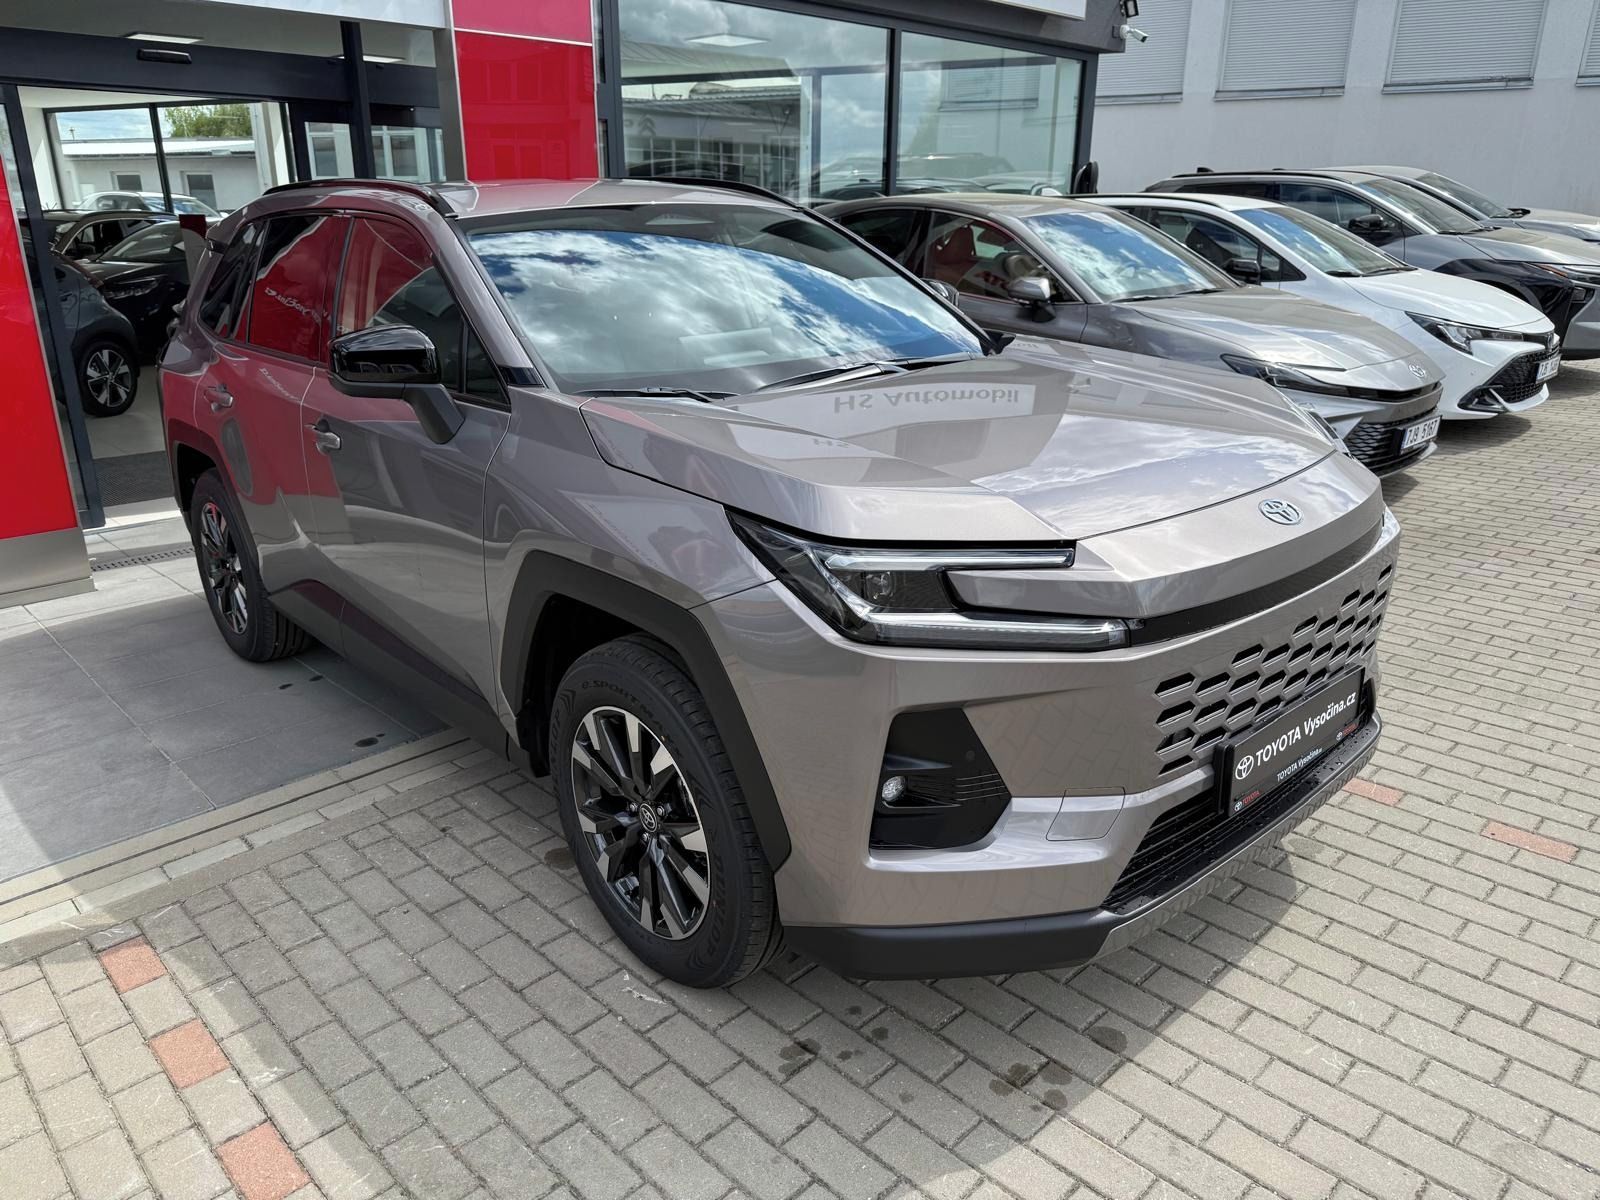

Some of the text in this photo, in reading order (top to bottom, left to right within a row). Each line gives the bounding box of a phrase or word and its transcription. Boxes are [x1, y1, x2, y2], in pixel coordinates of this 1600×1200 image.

[1256, 691, 1357, 766] TOYOTA Vysočina.cz
[1276, 763, 1298, 782] TOYOTA
